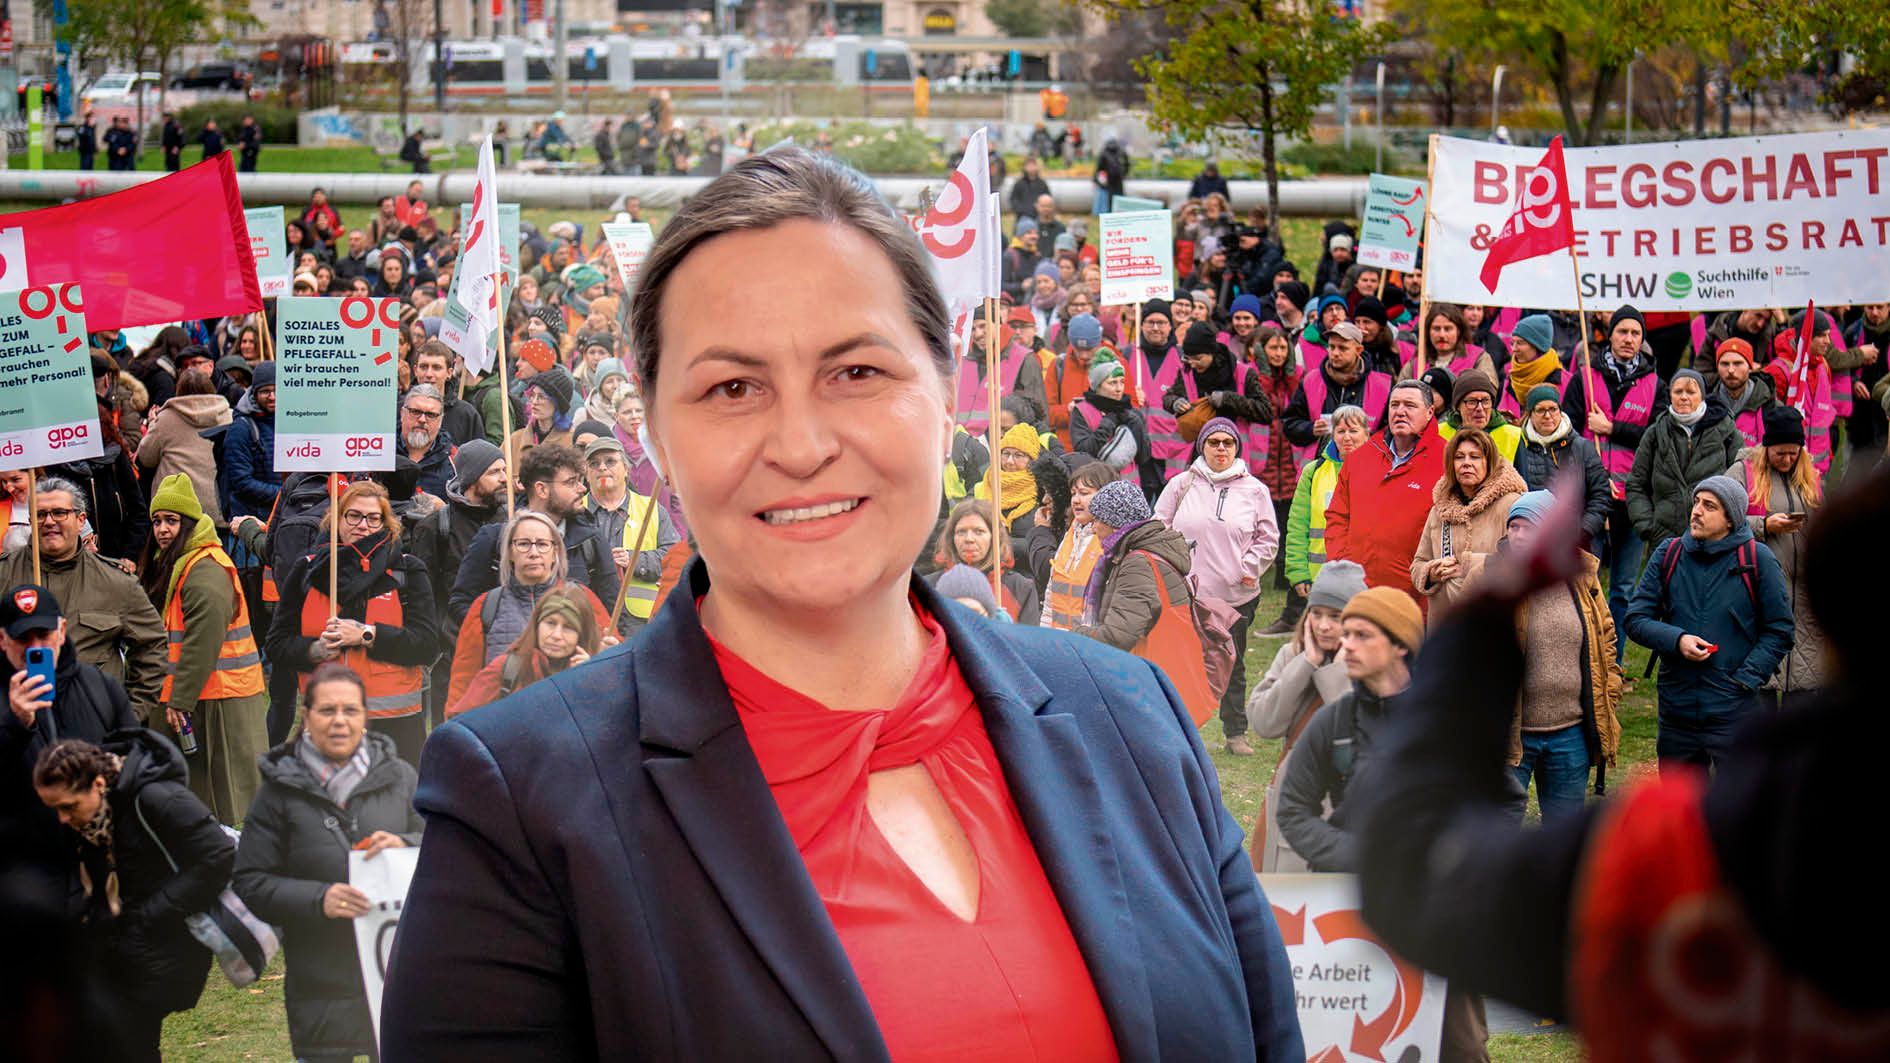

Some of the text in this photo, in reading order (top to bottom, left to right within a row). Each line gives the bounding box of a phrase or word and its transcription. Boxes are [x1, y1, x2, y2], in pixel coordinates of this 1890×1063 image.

[1474, 148, 1889, 209] BEGSCHAFT
[1470, 224, 1497, 251] &
[1568, 216, 1890, 257] ETRIEBSRAT
[1697, 268, 1768, 282] Suchthilfe
[1581, 273, 1658, 298] SHW
[1697, 286, 1735, 299] Wien
[284, 320, 340, 331] SOZIALES
[2, 330, 30, 343] ZUM
[284, 335, 344, 345] WIRD ZUM
[0, 344, 45, 359] GEFALL
[284, 349, 357, 359] PFLEGEFALL
[0, 359, 50, 373] rauchen
[284, 363, 360, 373] wir brauchen
[31, 366, 87, 384] Personal!
[283, 377, 391, 388] viel mehr Personal!
[48, 425, 88, 449] gpa
[286, 442, 321, 457] vida
[345, 437, 383, 457] gpa
[1308, 963, 1371, 982] Arbeit
[1295, 991, 1368, 1010] hr wert
